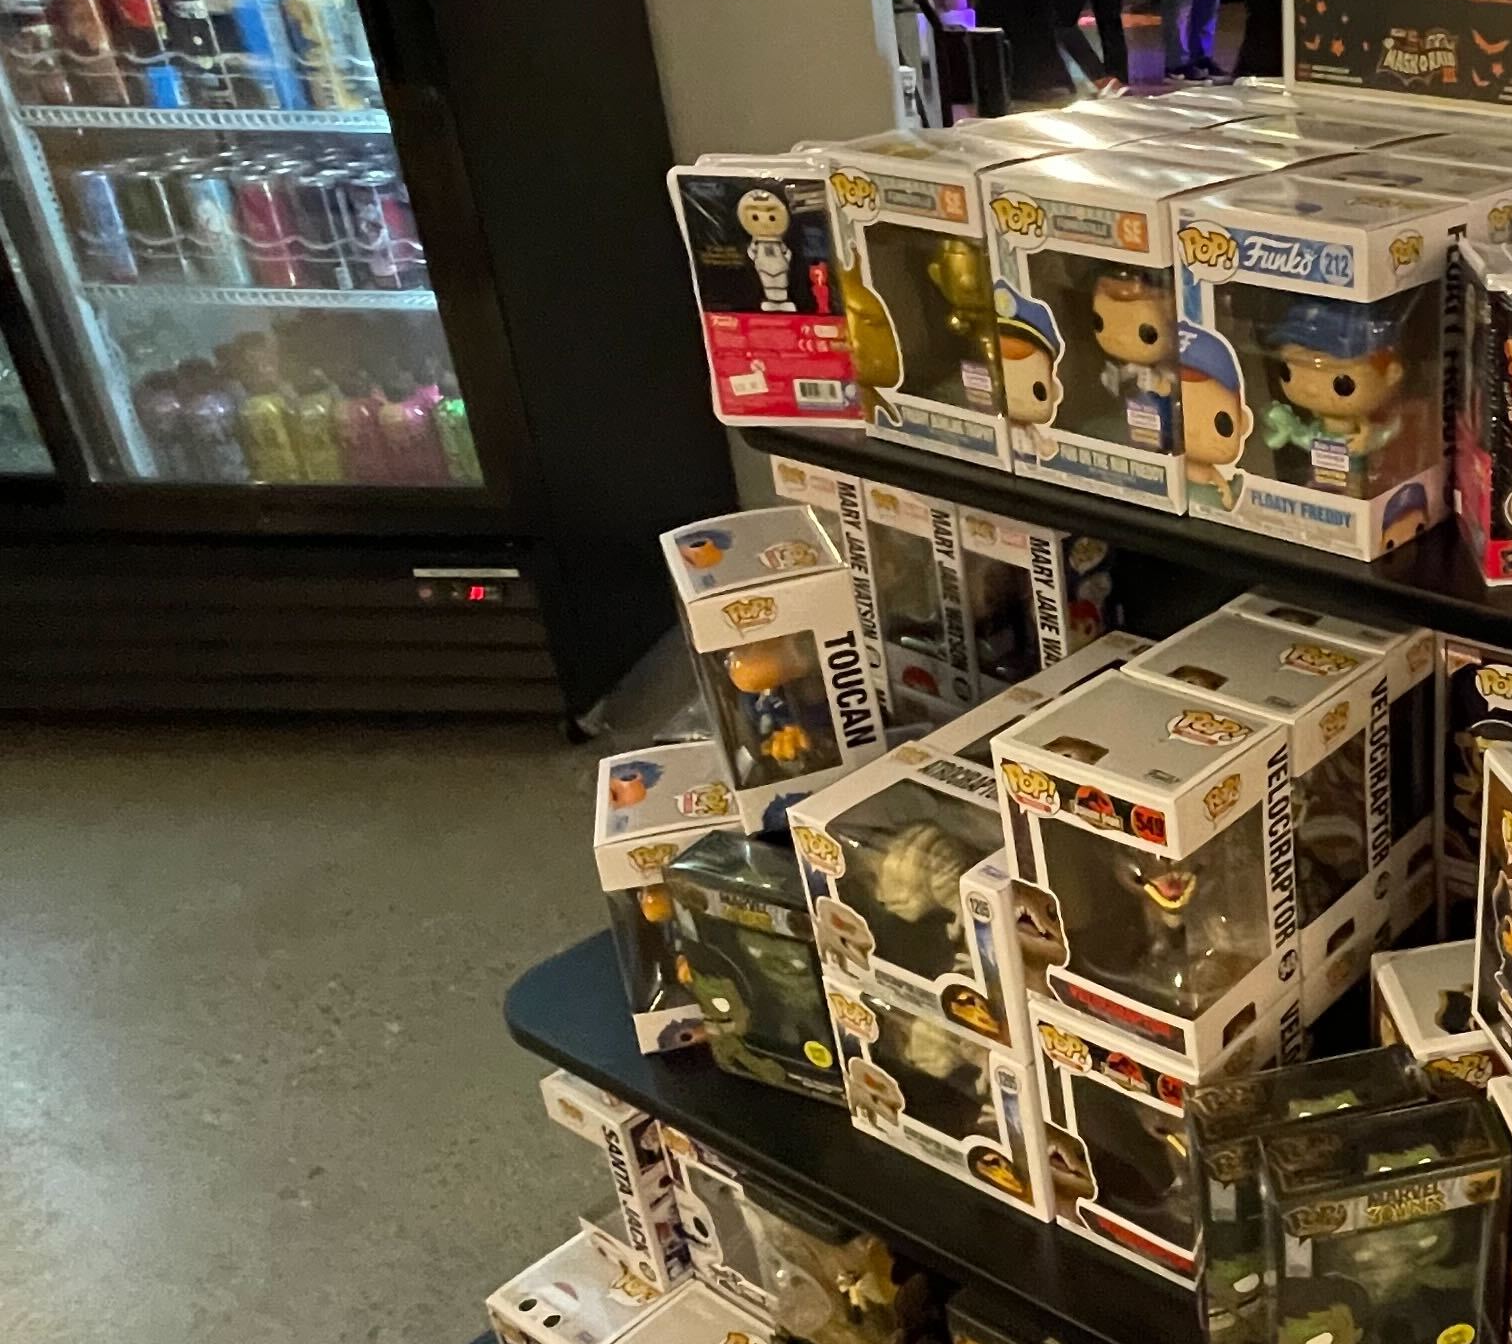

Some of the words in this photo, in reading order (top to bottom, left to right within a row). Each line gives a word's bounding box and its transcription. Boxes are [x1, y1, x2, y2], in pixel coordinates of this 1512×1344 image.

[830, 172, 876, 212] POP!
[990, 198, 1045, 238] POP!
[1122, 217, 1142, 243] SE
[1177, 227, 1238, 272] POP!
[1243, 235, 1316, 274] Funko
[1324, 248, 1350, 281] 212
[836, 481, 863, 532] MARY
[1251, 491, 1299, 517] FLOATY
[1301, 503, 1351, 529] FREDDY
[845, 532, 869, 579] JANE
[930, 508, 955, 560] MARY
[1029, 536, 1055, 589] MARY
[1036, 589, 1061, 639] JANE
[823, 630, 877, 749] TOUCAN
[1001, 759, 1056, 803] POP!
[1367, 675, 1392, 869] VELOCIRAPTOR
[1266, 743, 1298, 950] VELOCIRAPTOR
[1038, 1022, 1091, 1065] POP!
[602, 1125, 634, 1197] SANTA
